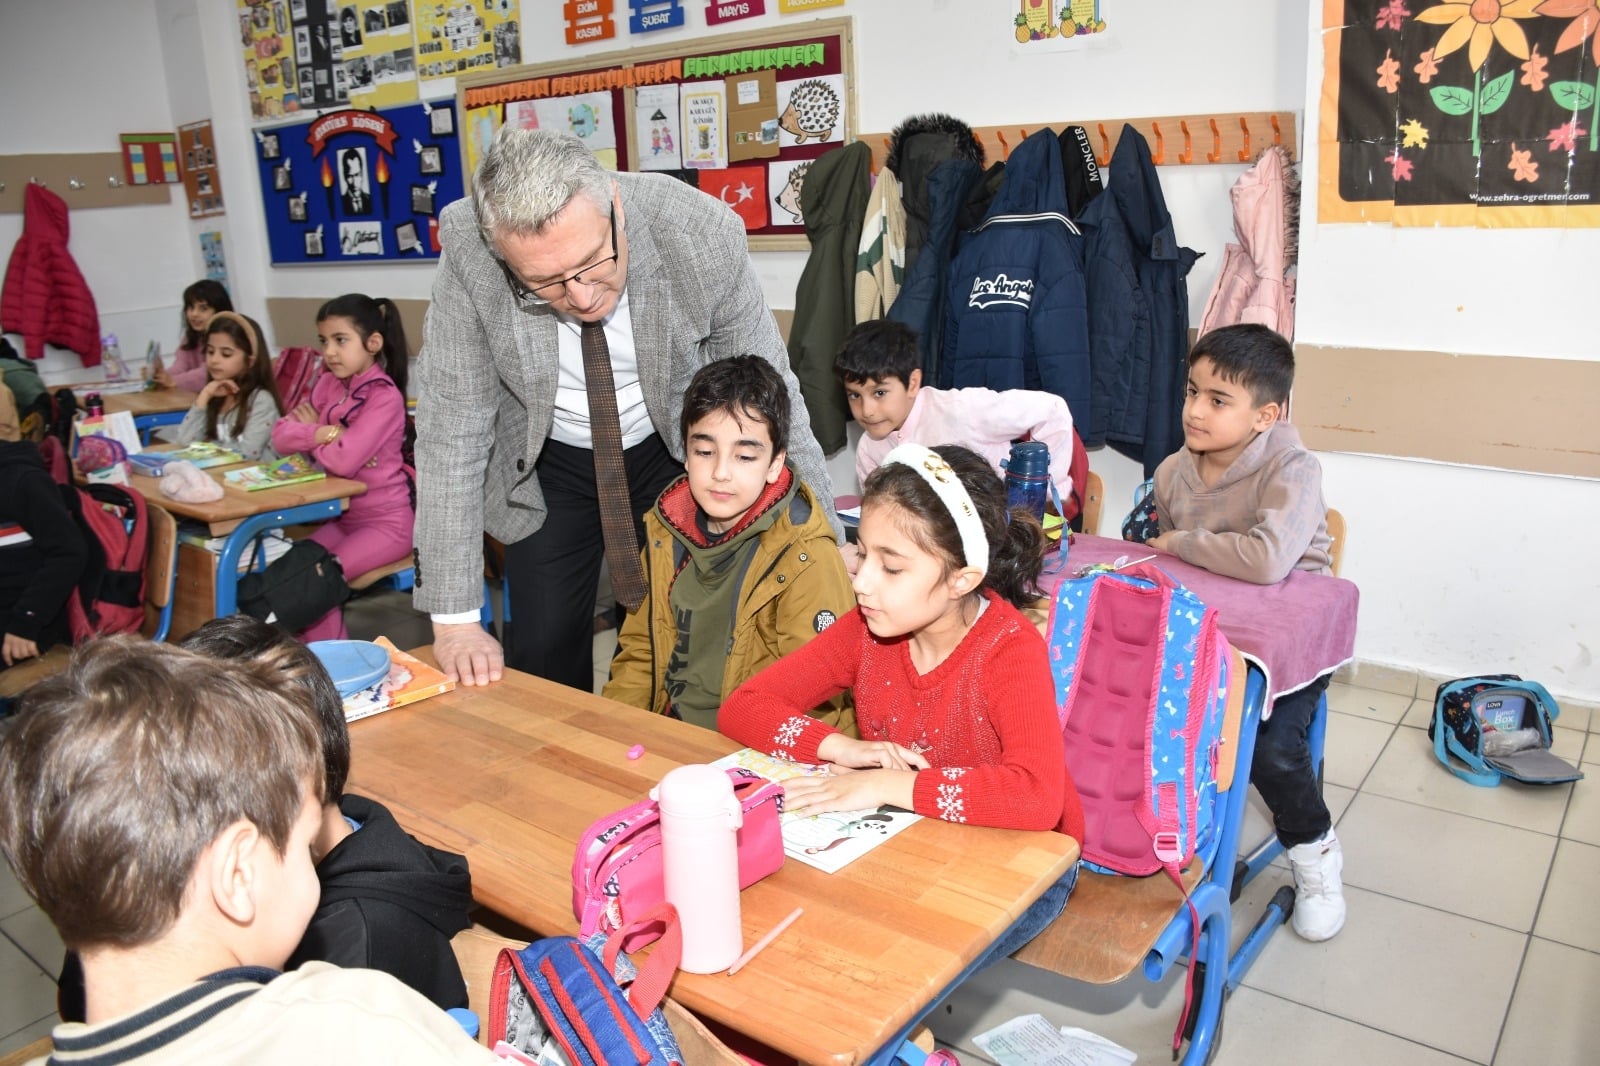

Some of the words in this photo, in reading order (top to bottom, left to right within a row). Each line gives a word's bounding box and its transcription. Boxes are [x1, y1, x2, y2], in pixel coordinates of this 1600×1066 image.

[718, 3, 749, 18] MAYIS
[642, 13, 671, 29] ŞUBAT
[576, 26, 602, 40] KASIM
[1074, 127, 1100, 182] MONCLER
[970, 277, 992, 297] Los
